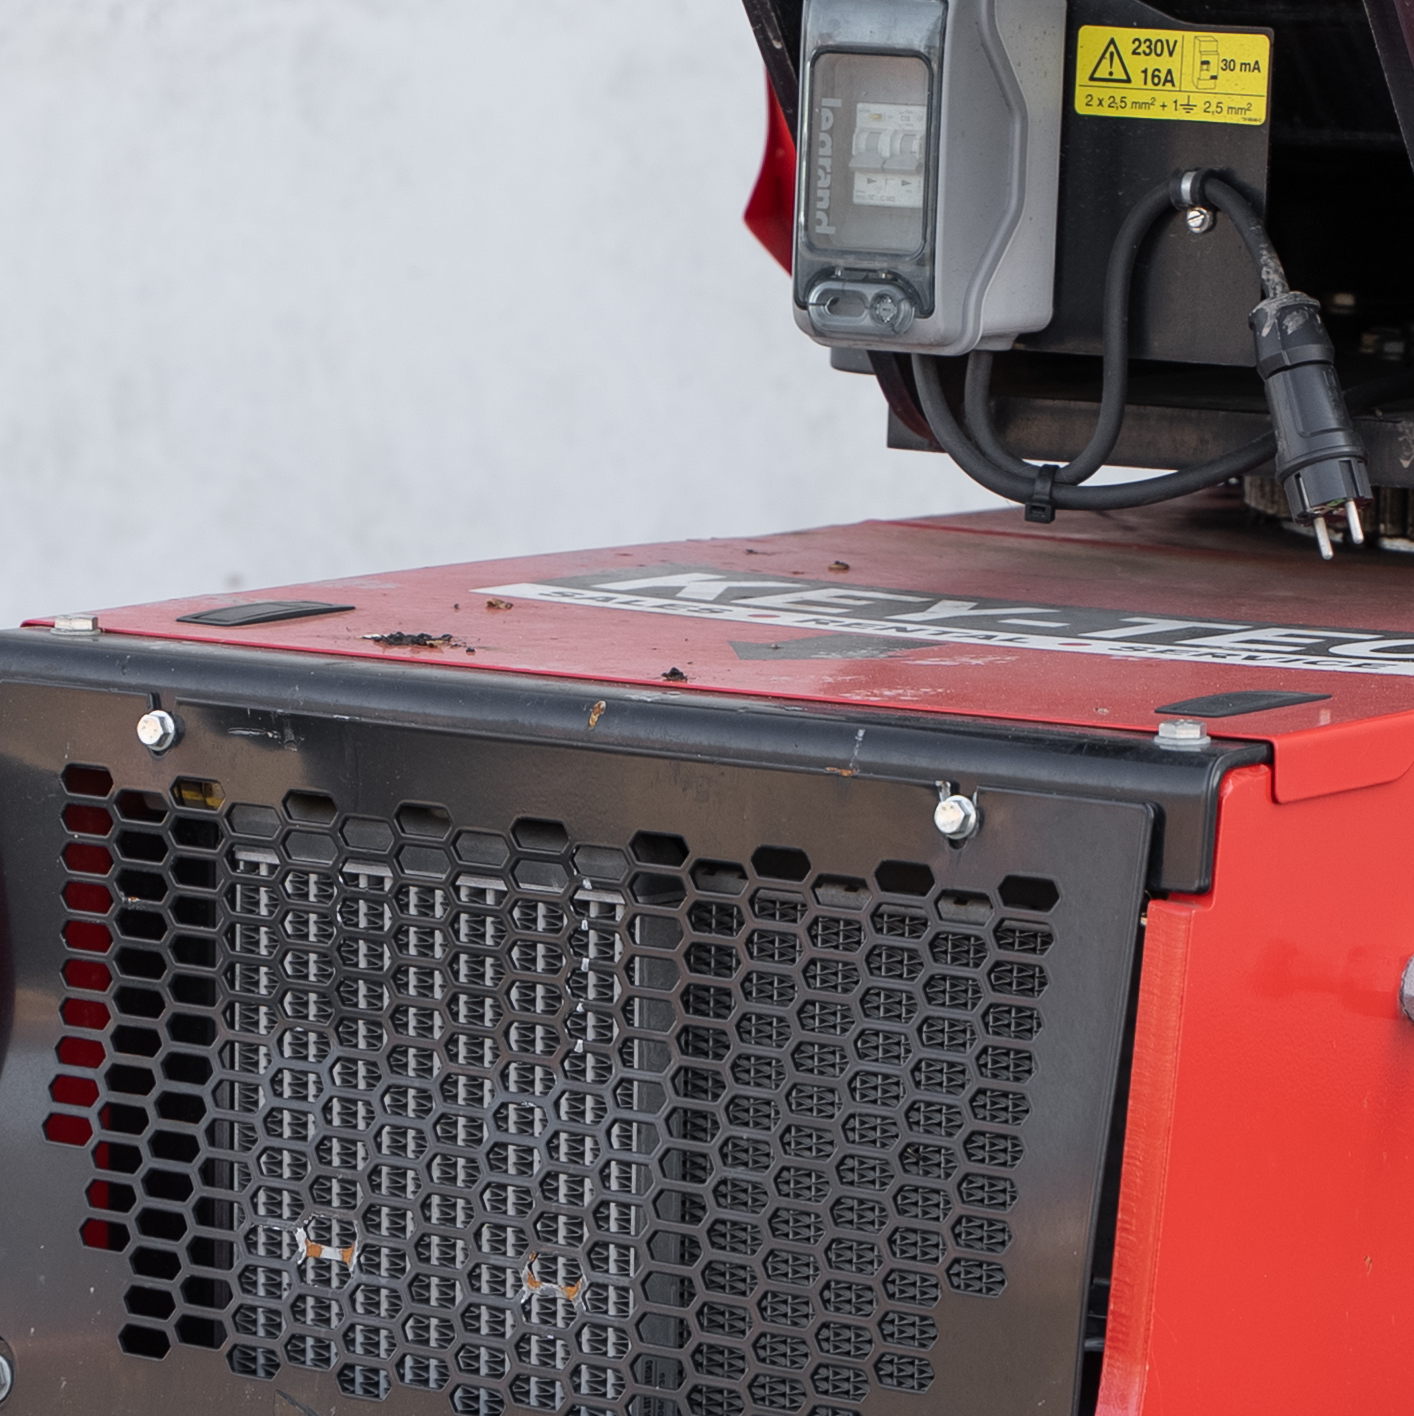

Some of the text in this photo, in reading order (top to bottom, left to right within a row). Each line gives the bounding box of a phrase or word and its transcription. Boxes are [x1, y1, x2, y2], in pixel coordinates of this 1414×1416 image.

[1131, 38, 1178, 57] 230V
[1220, 58, 1262, 73] 30 mA
[1140, 67, 1176, 87] 16A
[1085, 94, 1094, 107] 2
[1203, 100, 1224, 115] 2,5
[815, 98, 842, 235] legrand
[538, 591, 1399, 670] SALES RENTAL SERVICE
